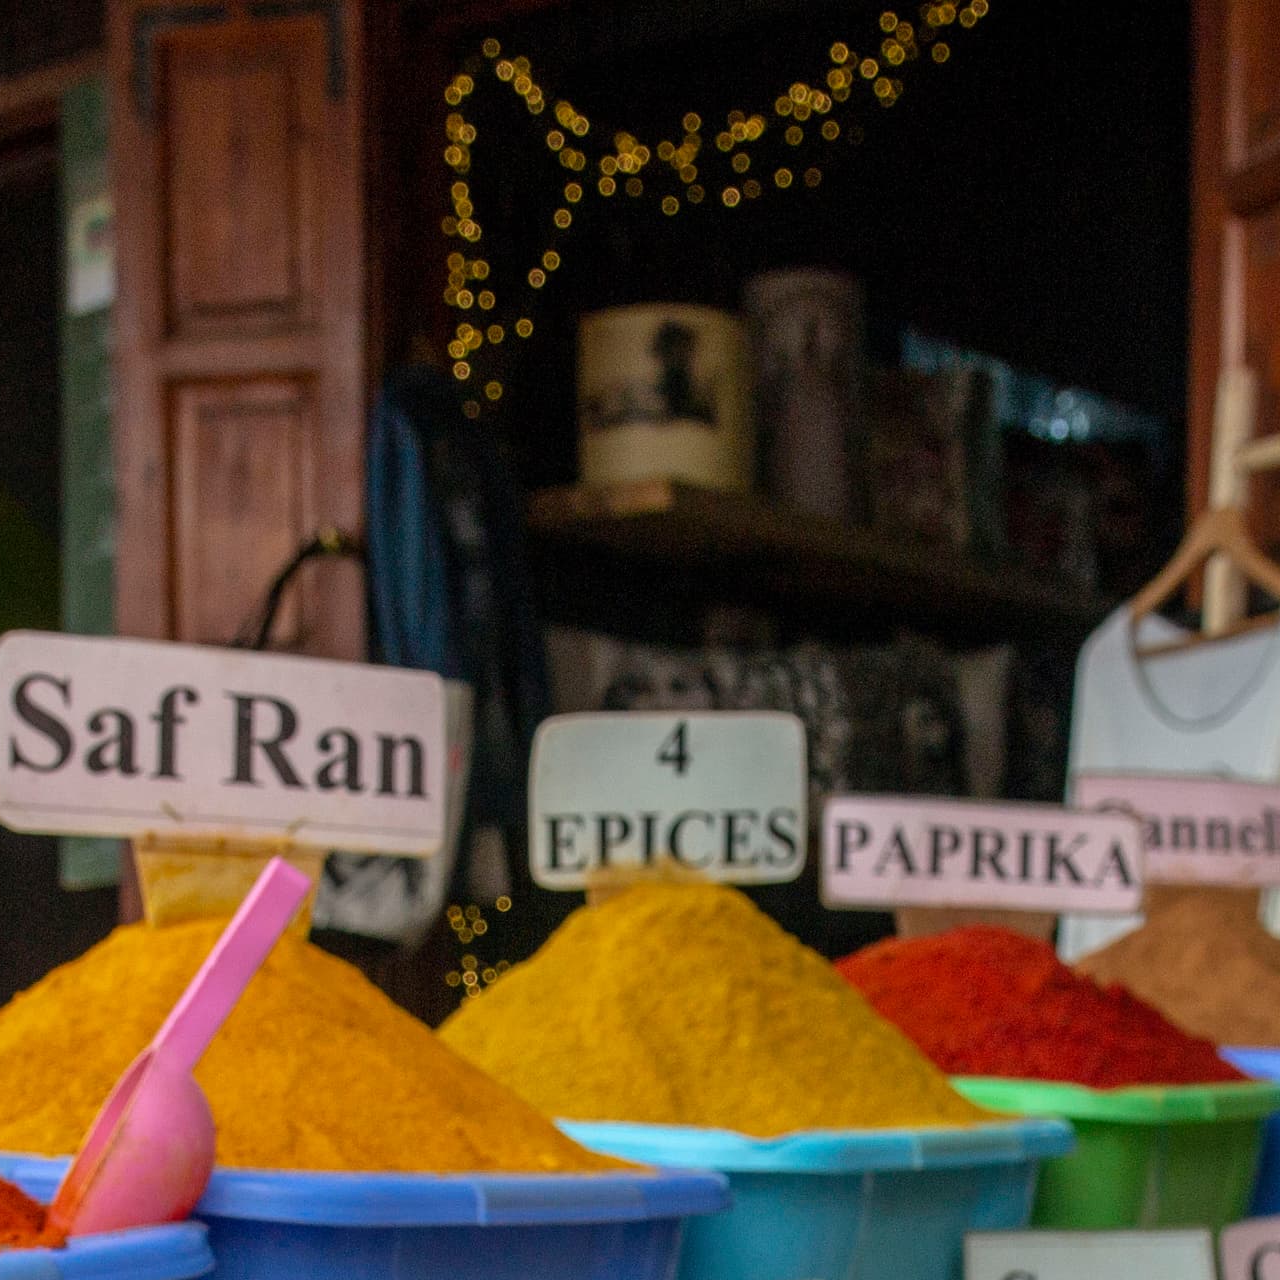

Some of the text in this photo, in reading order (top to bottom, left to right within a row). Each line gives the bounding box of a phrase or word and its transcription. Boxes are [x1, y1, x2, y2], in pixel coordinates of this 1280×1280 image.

[8, 671, 428, 800] Saf Ran
[655, 719, 691, 777] 4
[544, 806, 799, 872] EPICES
[833, 820, 1139, 887] PAPRIKA
